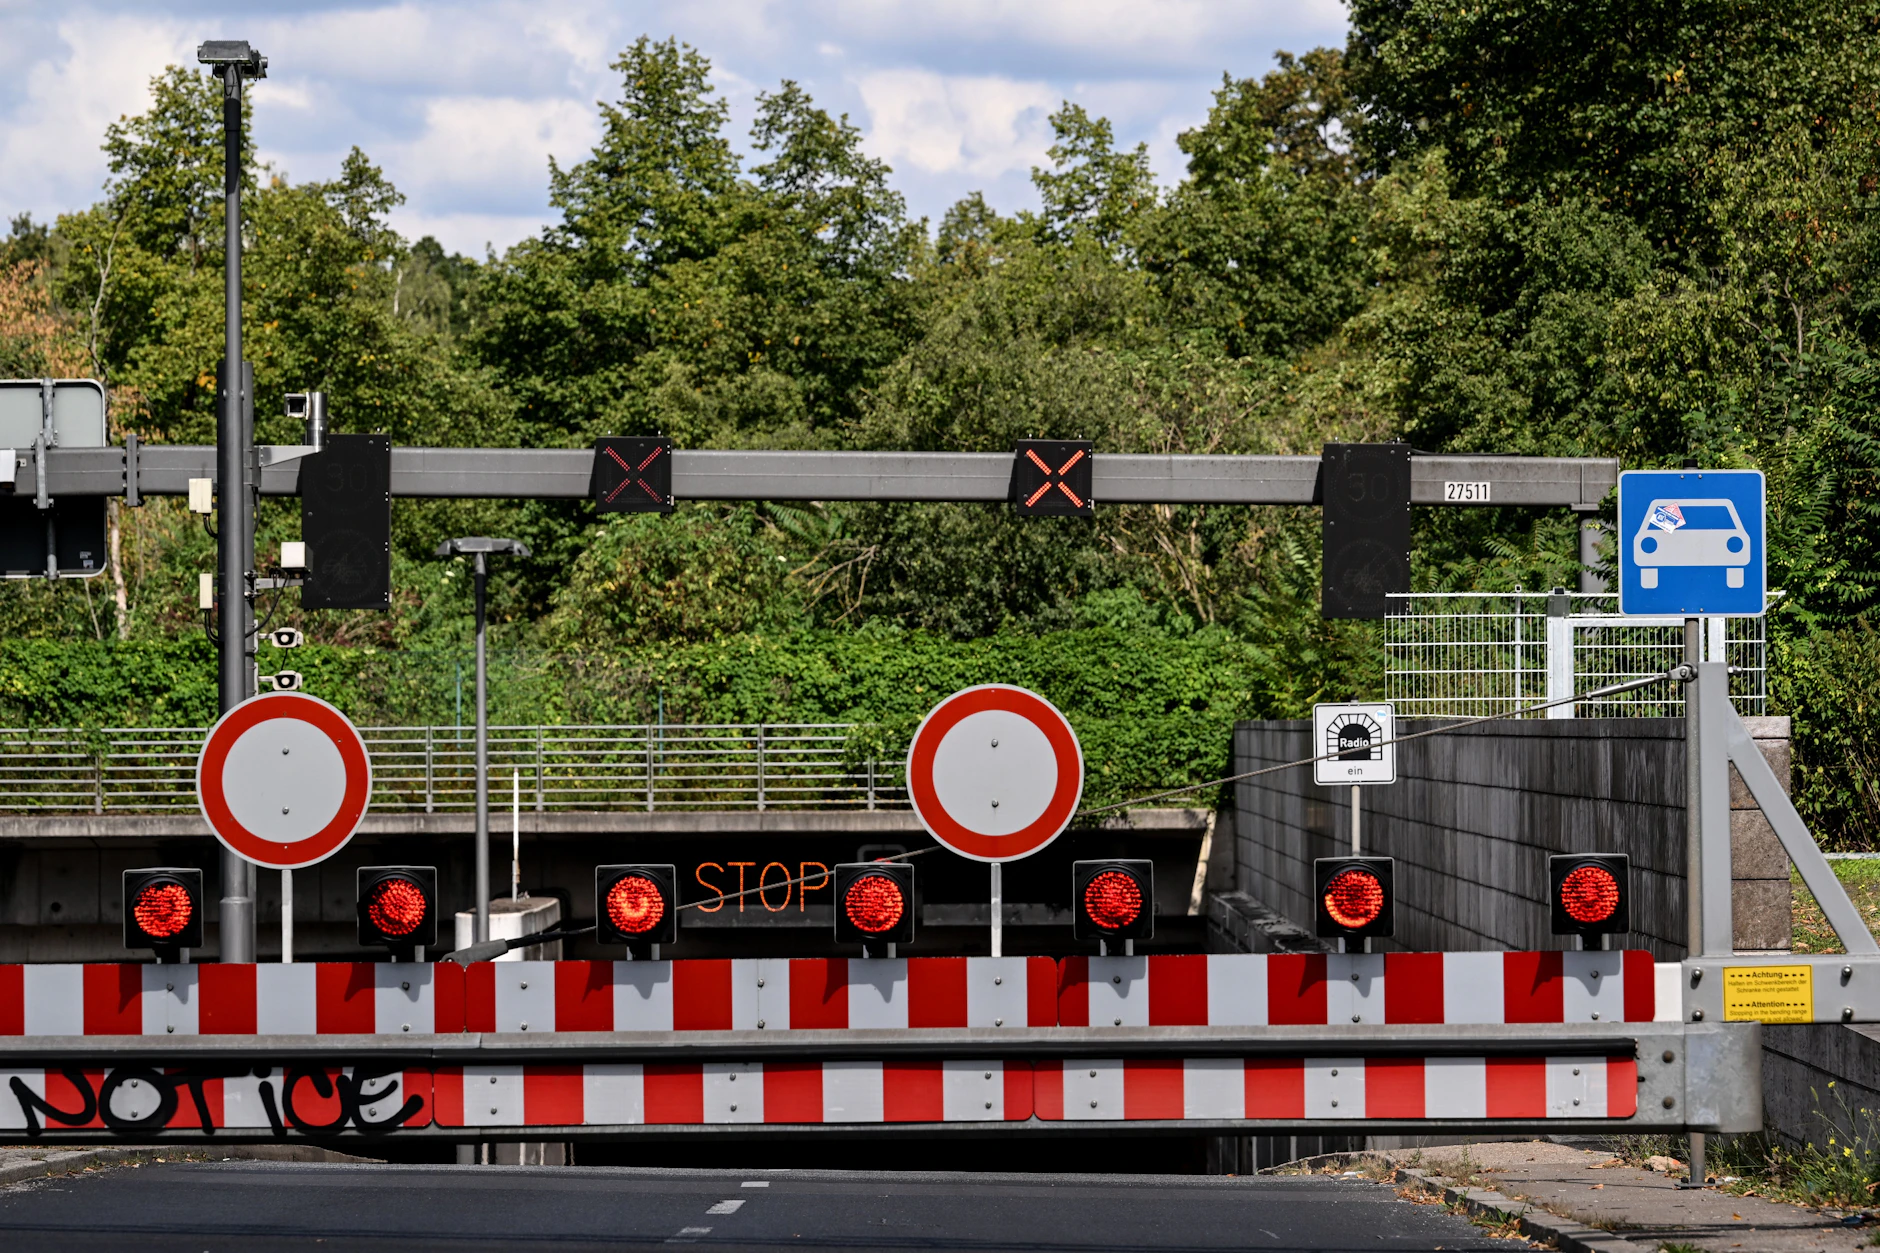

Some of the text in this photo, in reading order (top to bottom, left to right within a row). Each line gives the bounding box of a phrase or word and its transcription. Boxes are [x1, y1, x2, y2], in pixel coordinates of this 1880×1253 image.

[1448, 483, 1487, 499] 27511
[1340, 737, 1369, 748] Radio
[1347, 766, 1363, 775] ein
[695, 861, 829, 912] STOP
